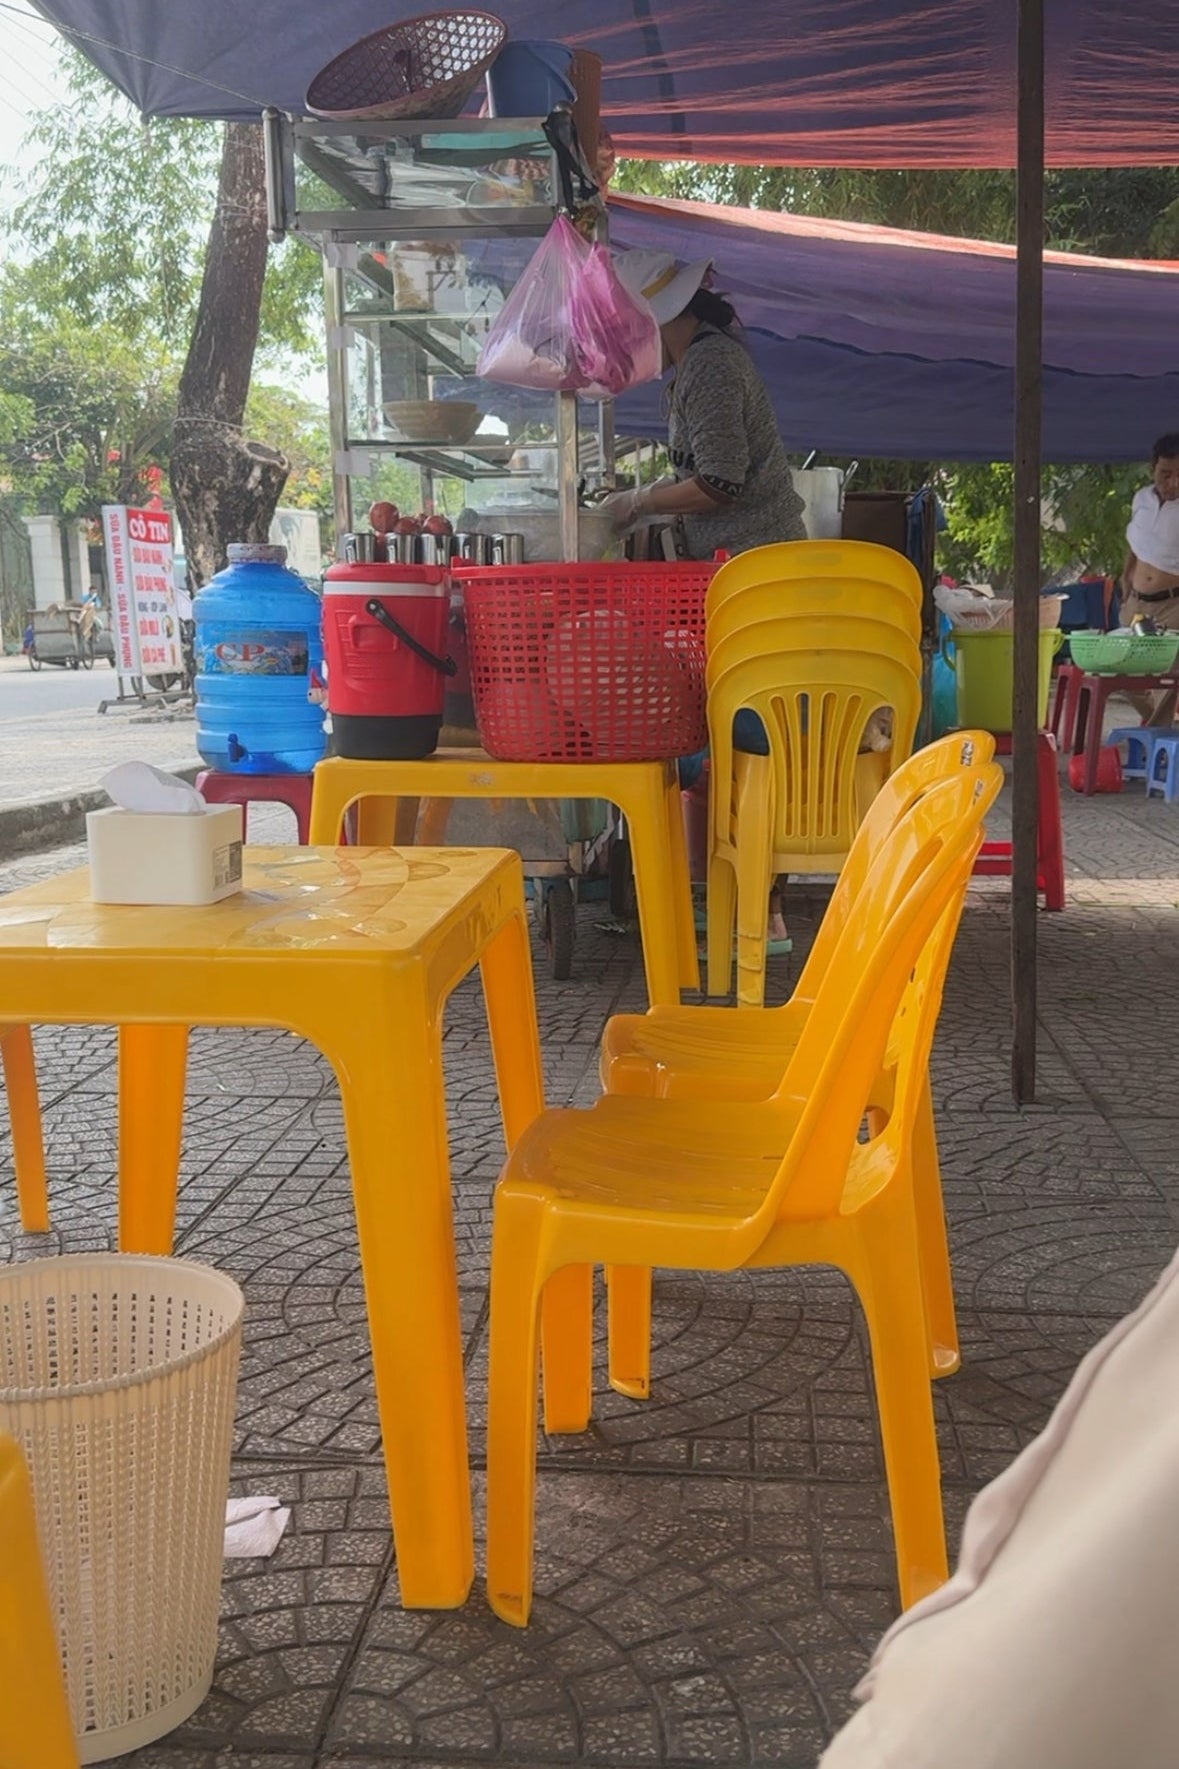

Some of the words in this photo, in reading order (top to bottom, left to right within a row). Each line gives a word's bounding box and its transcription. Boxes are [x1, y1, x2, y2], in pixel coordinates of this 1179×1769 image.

[129, 513, 147, 539] CÔ
[147, 520, 170, 542] TIN
[216, 643, 266, 662] CP
